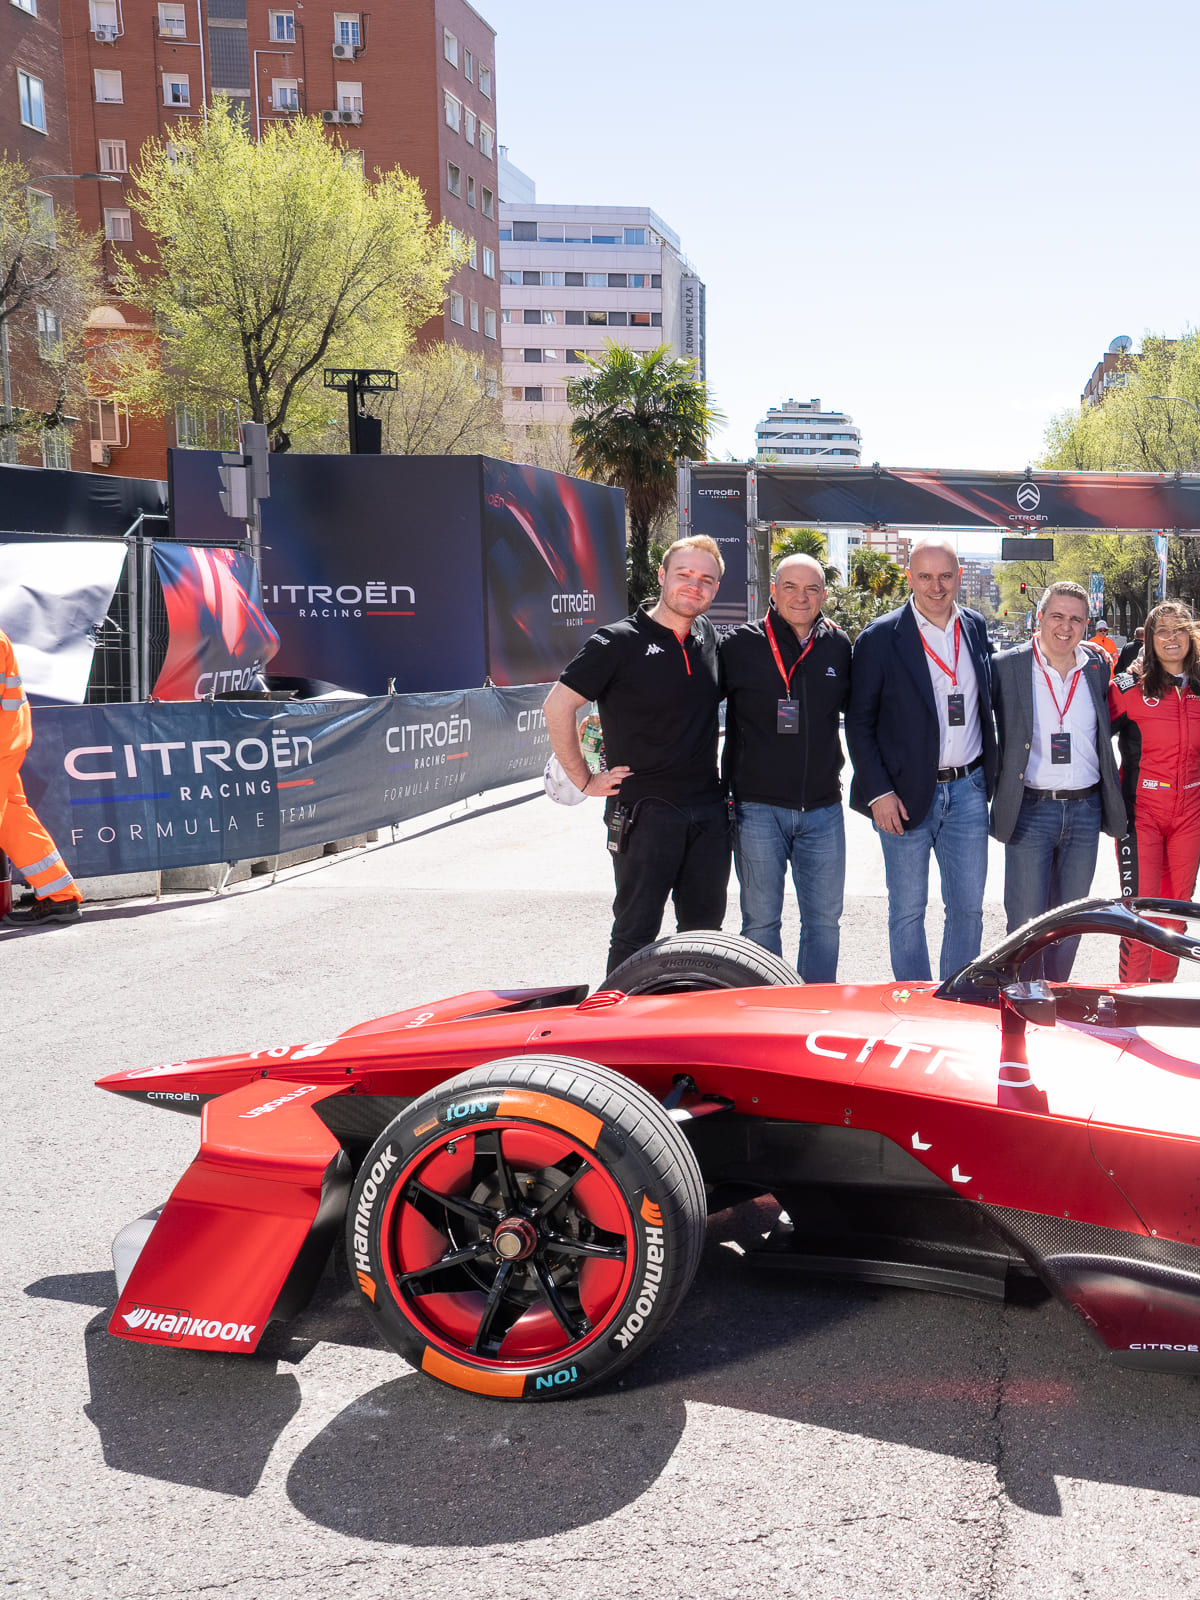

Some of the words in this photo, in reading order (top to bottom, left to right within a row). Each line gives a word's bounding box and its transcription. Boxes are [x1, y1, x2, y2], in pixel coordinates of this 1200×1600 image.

[685, 287, 694, 315] PLAZA
[685, 317, 694, 354] CROWNE
[299, 609, 363, 618] RACING
[551, 589, 596, 613] CITROËN
[386, 714, 471, 753] CITROËN
[64, 729, 313, 781] CITROËN
[414, 753, 446, 770] RACING
[180, 780, 272, 801] RACING
[384, 780, 431, 802] FORMULA
[434, 777, 440, 790] E
[443, 771, 466, 787] TEAM
[71, 815, 239, 846] FORMULA
[256, 812, 265, 828] E
[280, 804, 317, 825] TEAM
[147, 1091, 200, 1101] CITROËN
